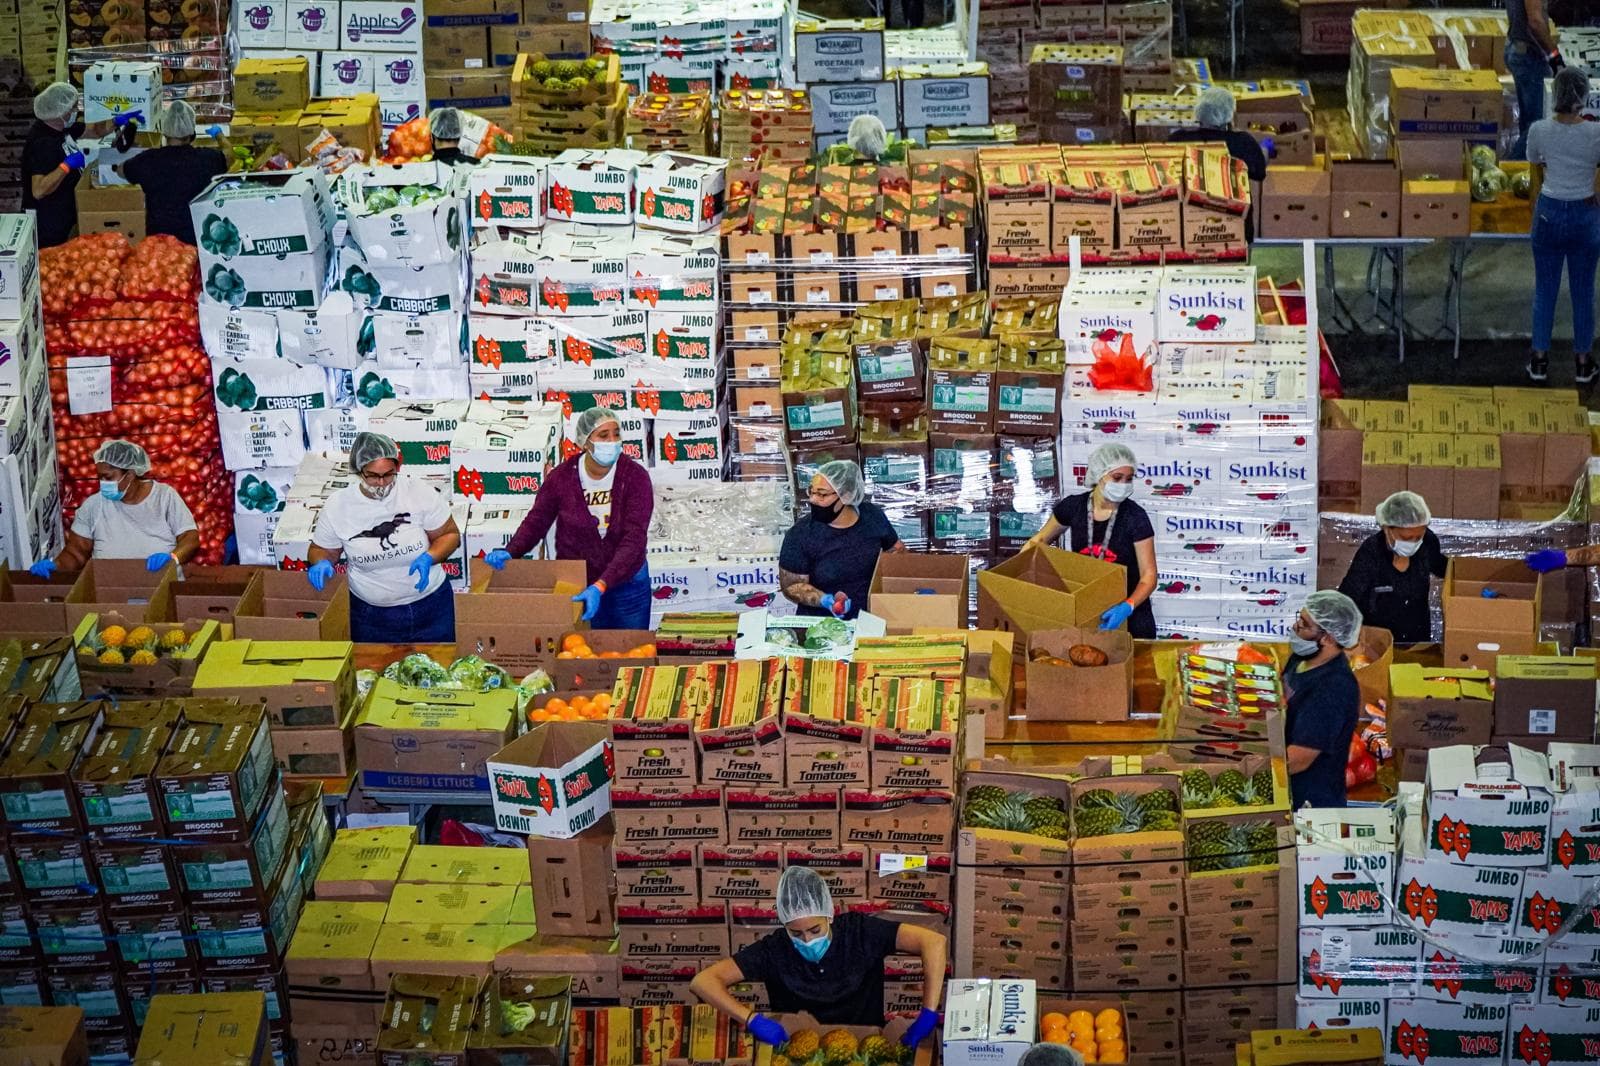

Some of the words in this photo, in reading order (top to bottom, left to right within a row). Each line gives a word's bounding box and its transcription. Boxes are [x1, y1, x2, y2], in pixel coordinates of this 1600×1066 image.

[349, 13, 399, 32] Apples
[631, 22, 656, 32] JUMBO
[700, 20, 725, 31] JUMBO
[753, 19, 779, 29] JUMBO
[689, 61, 714, 71] JUMBO
[814, 59, 865, 67] VEGETABLES
[921, 104, 971, 112] VEGETABLES
[504, 175, 535, 187] JUMBO
[594, 173, 625, 184] JUMBO
[667, 176, 698, 189] JUMBO
[499, 201, 530, 218] YAMS
[593, 196, 624, 212] YAMS
[662, 201, 691, 219] YAMS
[1006, 229, 1031, 238] Fresh
[1071, 228, 1096, 237] Fresh
[1137, 227, 1163, 236] Fresh
[1201, 225, 1227, 234] Fresh
[996, 237, 1040, 245] Tomatoes
[1128, 235, 1172, 244] Tomatoes
[1192, 232, 1236, 242] Tomatoes
[257, 237, 290, 255] CHOUX
[502, 262, 535, 274] JUMBO
[592, 263, 624, 274] JUMBO
[683, 257, 716, 270] JUMBO
[683, 281, 712, 297] YAMS
[994, 284, 1020, 293] Fresh
[262, 292, 297, 307] CHOUX
[390, 297, 439, 312] CABBAGE
[1169, 291, 1245, 312] Sunkist
[612, 314, 644, 327] JUMBO
[681, 315, 713, 327] JUMBO
[1080, 315, 1133, 330] Sunkist
[613, 337, 644, 353] YAMS
[677, 342, 707, 359] YAMS
[593, 367, 625, 380] JUMBO
[683, 367, 715, 379] JUMBO
[502, 375, 533, 387] JUMBO
[873, 381, 905, 389] BROCCOLI
[266, 396, 313, 410] CABBAGE
[593, 392, 624, 409] YAMS
[683, 391, 712, 408] YAMS
[943, 413, 976, 421] BROCCOLI
[1010, 413, 1043, 421] BROCCOLI
[1082, 407, 1136, 421] Sunkist
[1177, 408, 1232, 422] Sunkist
[425, 420, 458, 432] JUMBO
[252, 431, 277, 439] CABBAGE
[802, 430, 835, 438] BROCCOLI
[424, 445, 450, 461] YAM
[508, 451, 541, 463] JUMBO
[684, 443, 715, 460] YAMS
[689, 468, 720, 480] JUMBO
[1135, 460, 1212, 481] Sunkist
[1229, 460, 1307, 481] Sunkist
[506, 475, 539, 491] YAMS
[1165, 513, 1245, 535] Sunkist
[638, 757, 670, 768] Fresh
[728, 760, 761, 771] Fresh
[811, 762, 845, 772] Fresh
[625, 767, 683, 777] Tomatoes
[715, 769, 773, 781] Tomatoes
[799, 770, 857, 781] Tomatoes
[896, 767, 930, 778] Fresh
[387, 775, 430, 787] ICEBERG
[432, 777, 475, 788] LETTUCE
[884, 776, 942, 786] Tomatoes
[1507, 800, 1550, 816] JUMBO
[22, 821, 60, 830] BROCCOLI
[103, 824, 142, 833] BROCCOLI
[184, 822, 224, 831] BROCCOLI
[625, 827, 659, 838] Fresh
[662, 826, 719, 837] Tomatoes
[738, 827, 772, 838] Fresh
[774, 827, 833, 837] Tomatoes
[849, 828, 883, 839] Fresh
[887, 831, 944, 842] Tomatoes
[1502, 830, 1543, 851] YAMS
[640, 875, 673, 885] Fresh
[726, 878, 760, 888] Fresh
[1475, 869, 1519, 886] JUMBO
[628, 884, 685, 894] Tomatoes
[714, 886, 772, 896] Tomatoes
[892, 880, 926, 891] Fresh
[40, 888, 78, 896] BROCCOLI
[121, 894, 159, 902] BROCCOLI
[203, 891, 242, 899] BROCCOLI
[880, 888, 937, 899] Tomatoes
[1338, 889, 1381, 911] YAMS
[1468, 898, 1509, 922] YAMS
[1374, 931, 1418, 946] JUMBO
[628, 944, 661, 953] Fresh
[665, 943, 721, 953] Tomatoes
[1493, 970, 1533, 992] YAMS
[642, 989, 674, 999] Fresh
[1338, 1001, 1381, 1016] JUMBO
[1463, 1005, 1506, 1021] JUMBO
[968, 1044, 1005, 1054] Sunkist
[1458, 1035, 1499, 1055] YAMS
